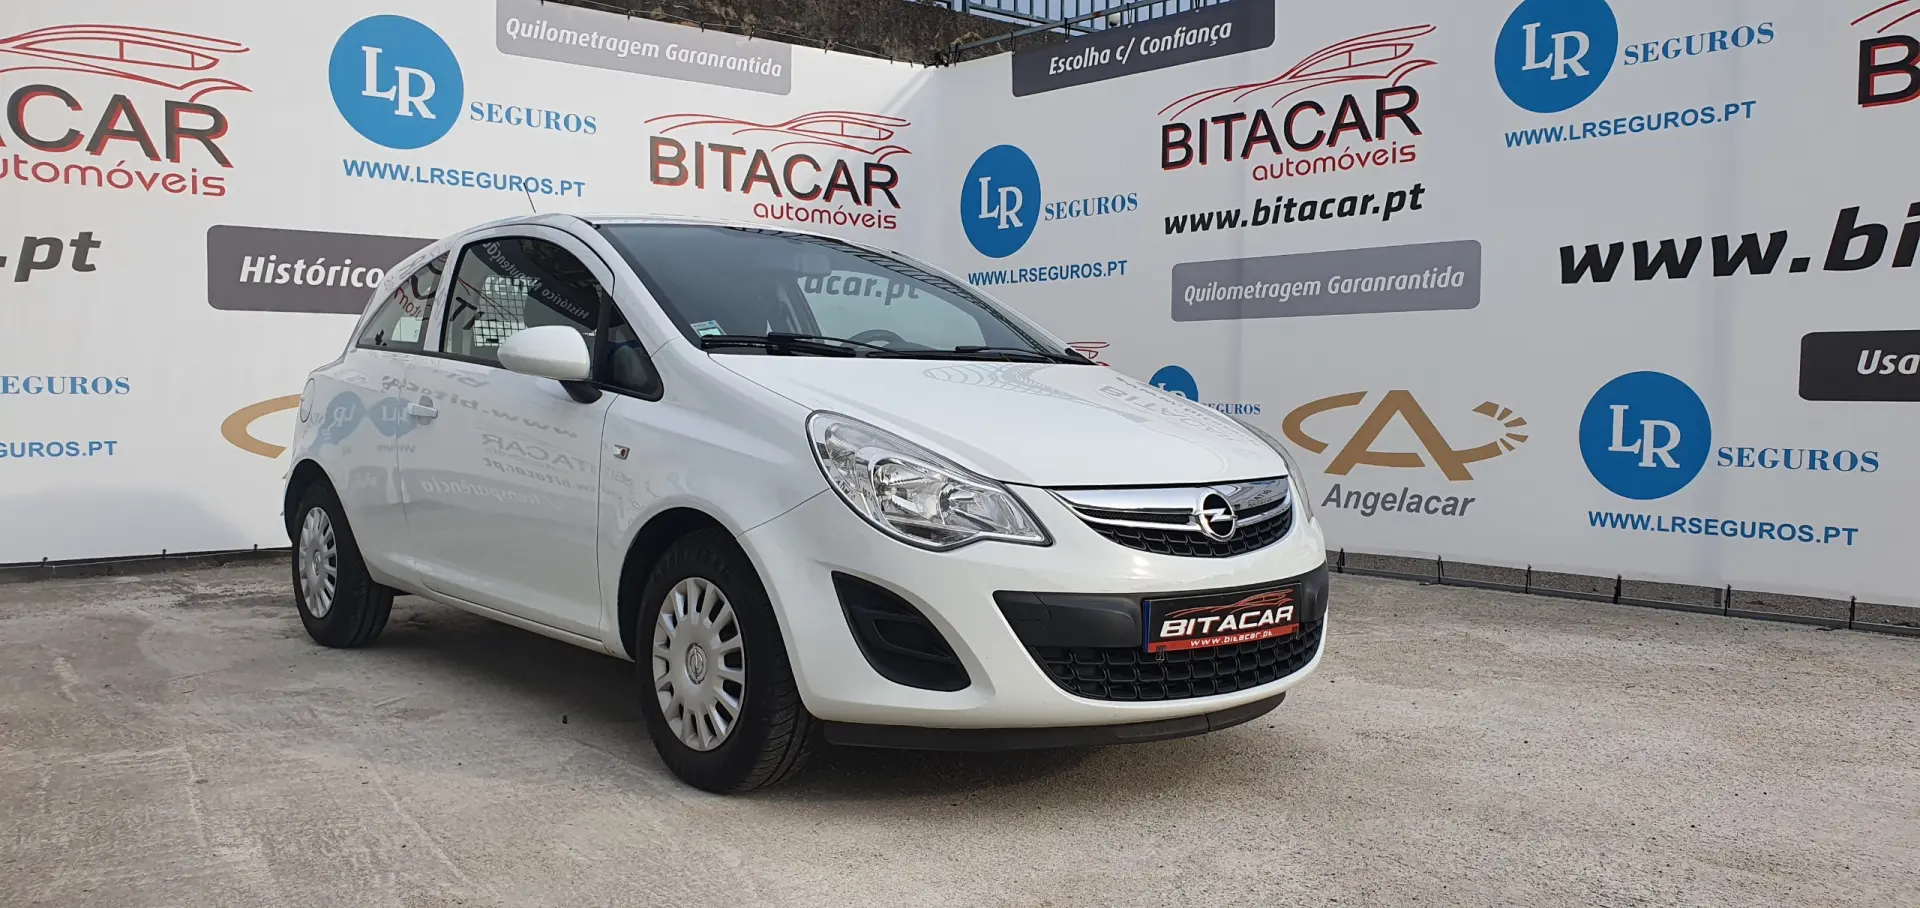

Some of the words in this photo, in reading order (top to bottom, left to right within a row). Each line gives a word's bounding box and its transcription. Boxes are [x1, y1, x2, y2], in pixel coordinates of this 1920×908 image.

[505, 17, 660, 58] Quilometragem
[665, 42, 783, 78] Garanrantida
[1048, 49, 1111, 76] Escolha
[1115, 38, 1136, 66] c/
[1138, 19, 1233, 57] Confiança
[1521, 22, 1590, 81] LR
[1624, 21, 1776, 67] SEGUROS
[361, 46, 436, 120] LR
[0, 84, 234, 168] CAR
[469, 101, 597, 135] SEGUROS
[1162, 84, 1422, 170] BITACAR
[1504, 101, 1756, 148] WWW.LRSEGUROS.PT
[343, 159, 585, 198] WWW.LRSEGUROS.PT
[649, 136, 901, 209] BITACAR
[1252, 140, 1416, 181] automóveis
[753, 201, 897, 230] automóveis
[978, 176, 1023, 230] LR
[1044, 192, 1138, 222] SEGUROS
[1164, 183, 1425, 235] www.bitacar.pt
[239, 254, 386, 289] Histórico
[968, 260, 1128, 287] WWW.LRSEGUROS.PT
[1184, 276, 1321, 306] Quilometragem
[1327, 265, 1465, 295] Garanrantida
[1201, 402, 1261, 416] GUROS
[1608, 404, 1681, 468] LR
[1717, 446, 1879, 473] SEGUROS
[1321, 483, 1475, 517] Angelacar
[1588, 510, 1859, 546] WWW.LRSEGUROS.PT
[1160, 605, 1294, 638] BITACAR
[1190, 630, 1273, 647] www.bitacar.pt
